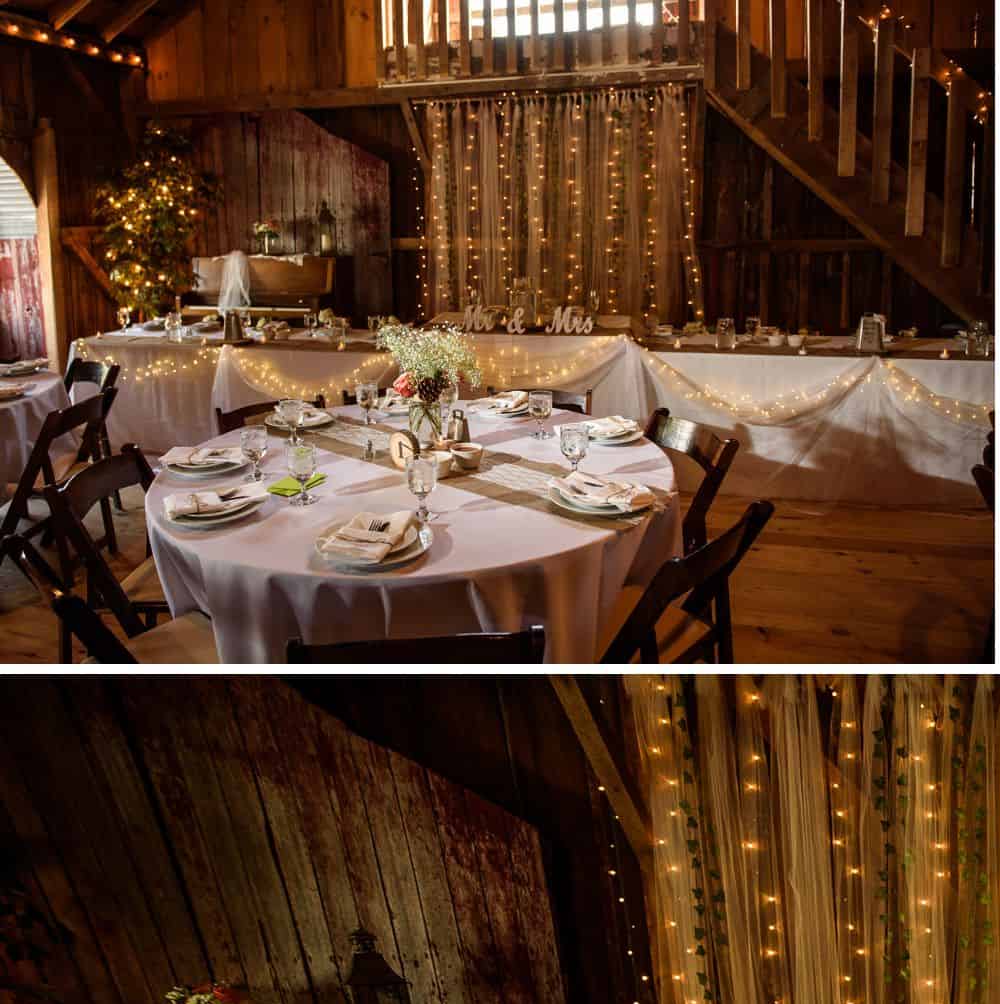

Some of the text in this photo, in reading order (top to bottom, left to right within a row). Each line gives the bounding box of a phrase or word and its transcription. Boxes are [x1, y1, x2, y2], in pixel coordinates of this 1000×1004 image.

[451, 305, 593, 334] Mr & Mrs
